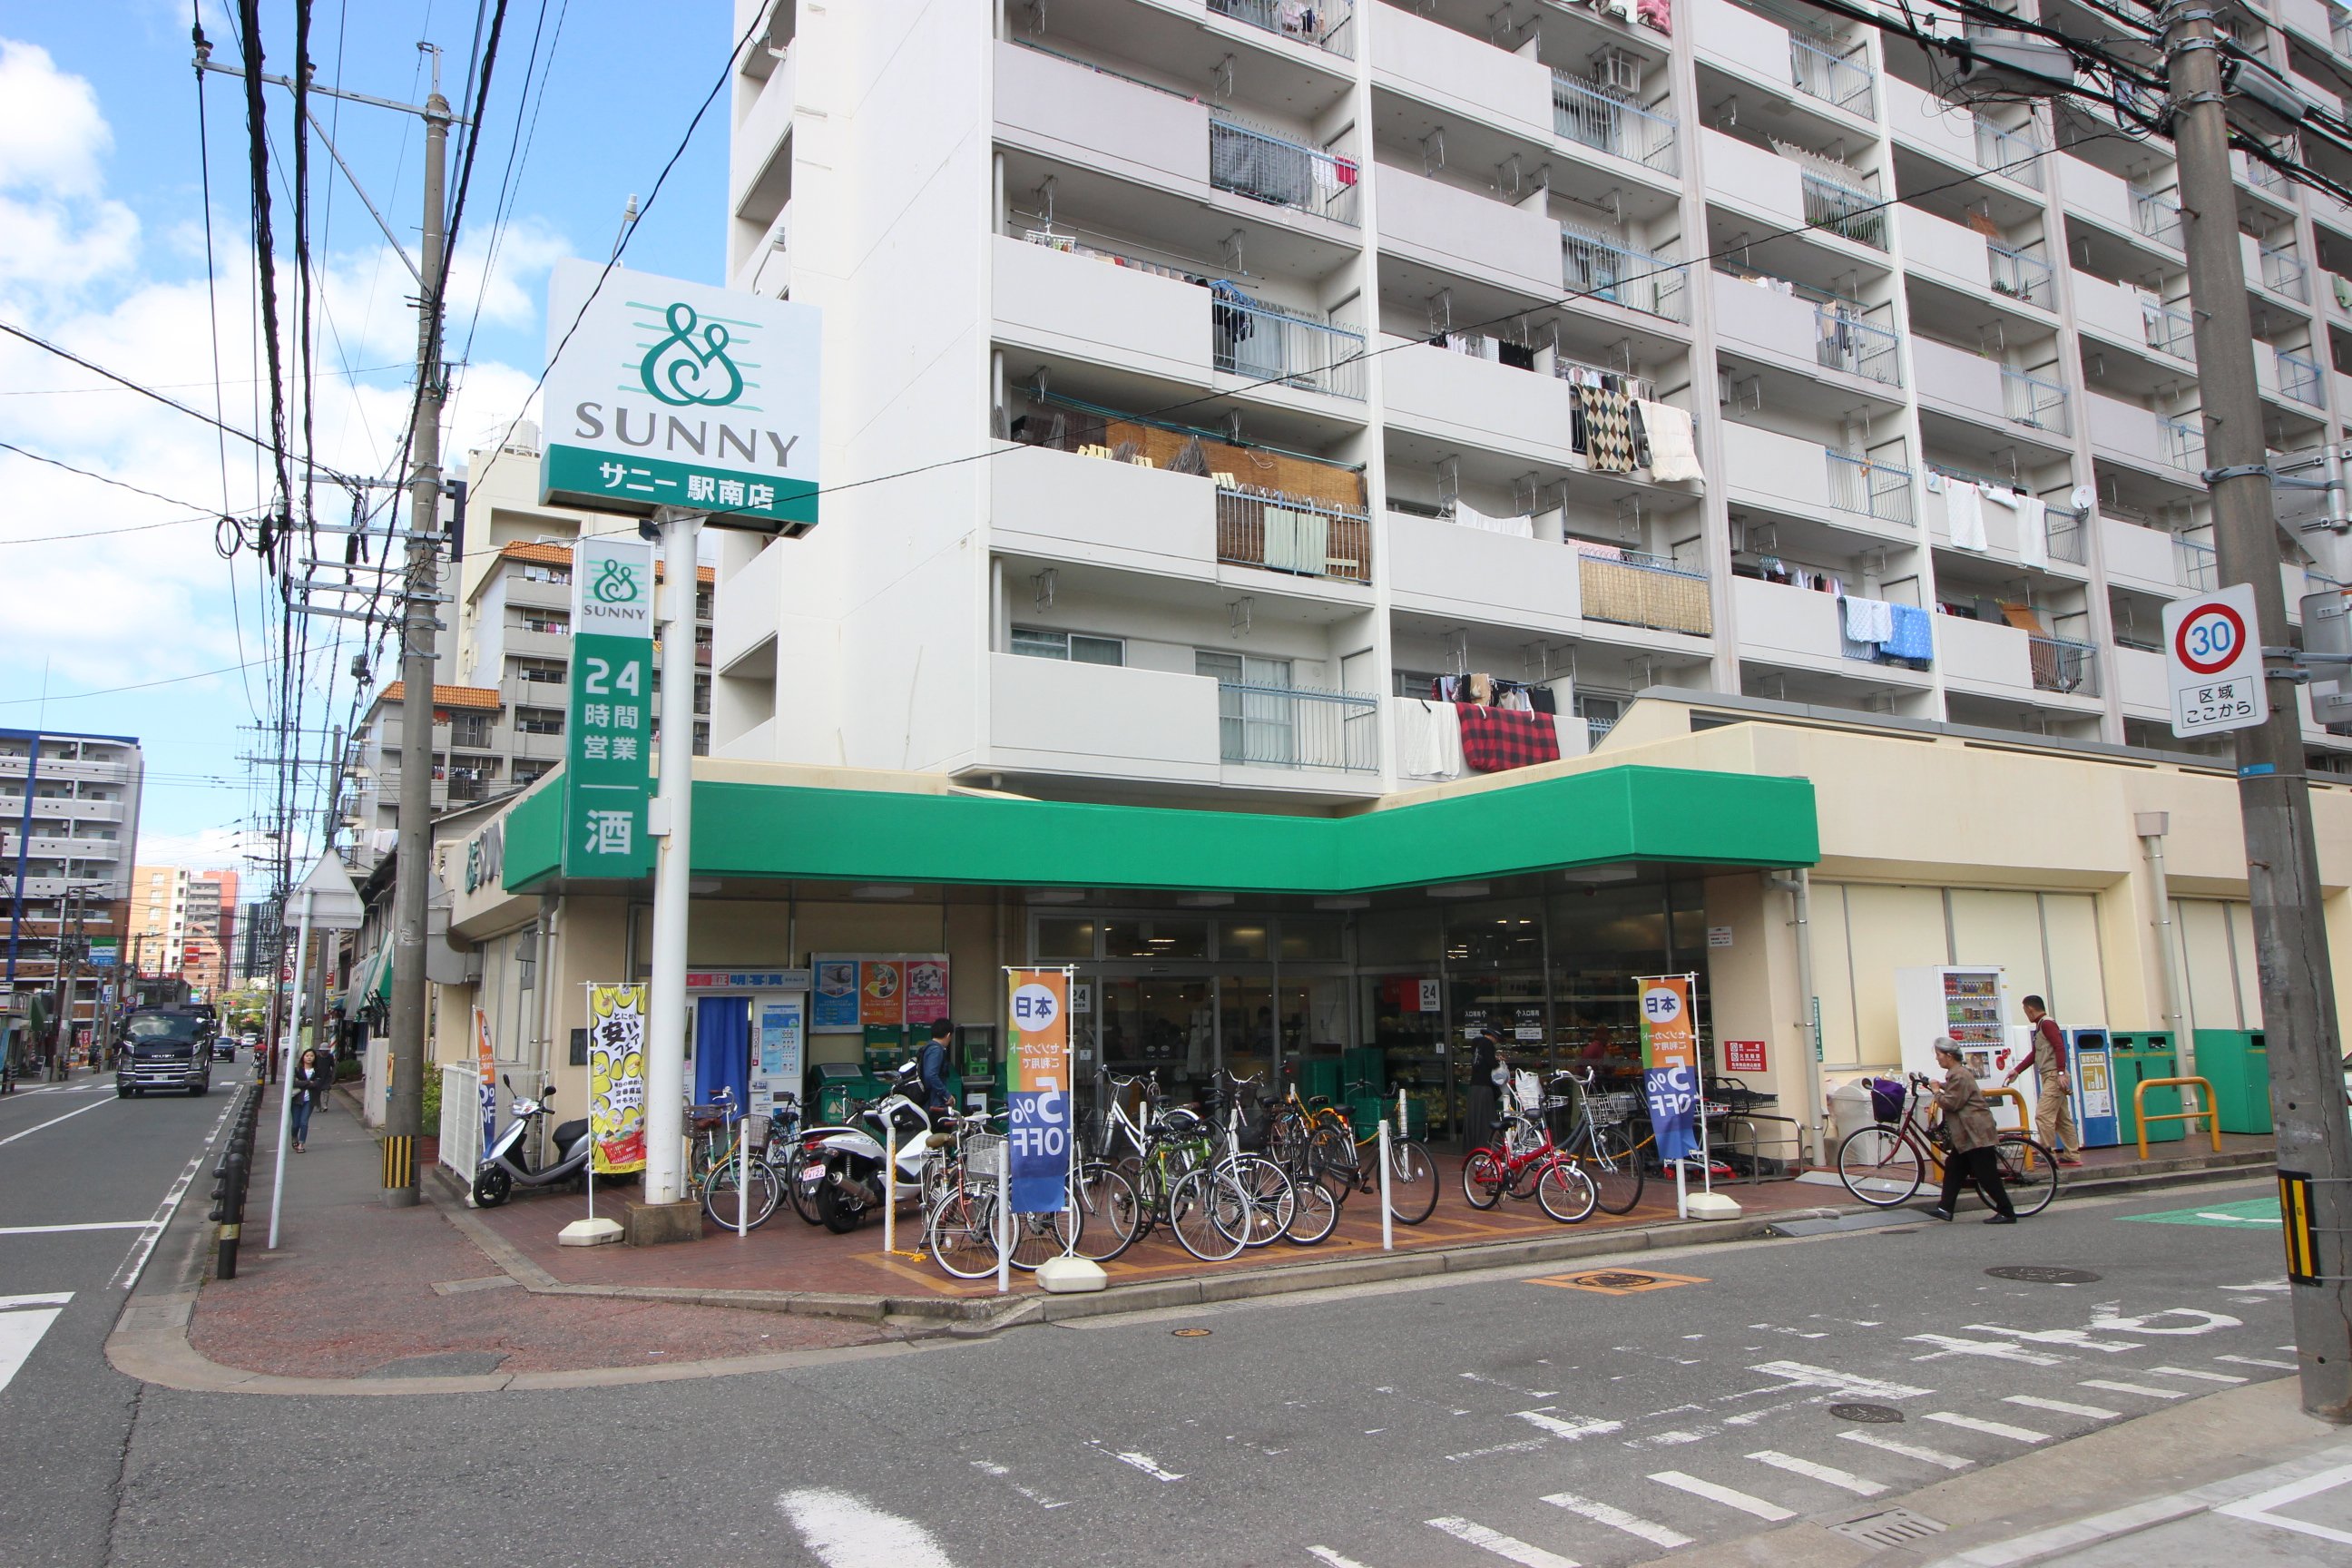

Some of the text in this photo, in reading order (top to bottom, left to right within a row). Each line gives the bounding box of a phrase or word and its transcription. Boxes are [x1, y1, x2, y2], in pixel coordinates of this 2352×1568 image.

[574, 402, 799, 467] SUNNY
[599, 461, 775, 511] サニー 駅南店
[583, 603, 646, 621] SUNNY
[2191, 621, 2231, 656] 30
[585, 657, 640, 697] 24
[2199, 685, 2234, 704] 区域
[584, 703, 639, 730] 時間
[2187, 701, 2251, 724] ここから
[583, 734, 638, 761] 営業
[585, 809, 633, 855] 酒
[1423, 985, 1436, 999] 24
[602, 1021, 640, 1046] 安い
